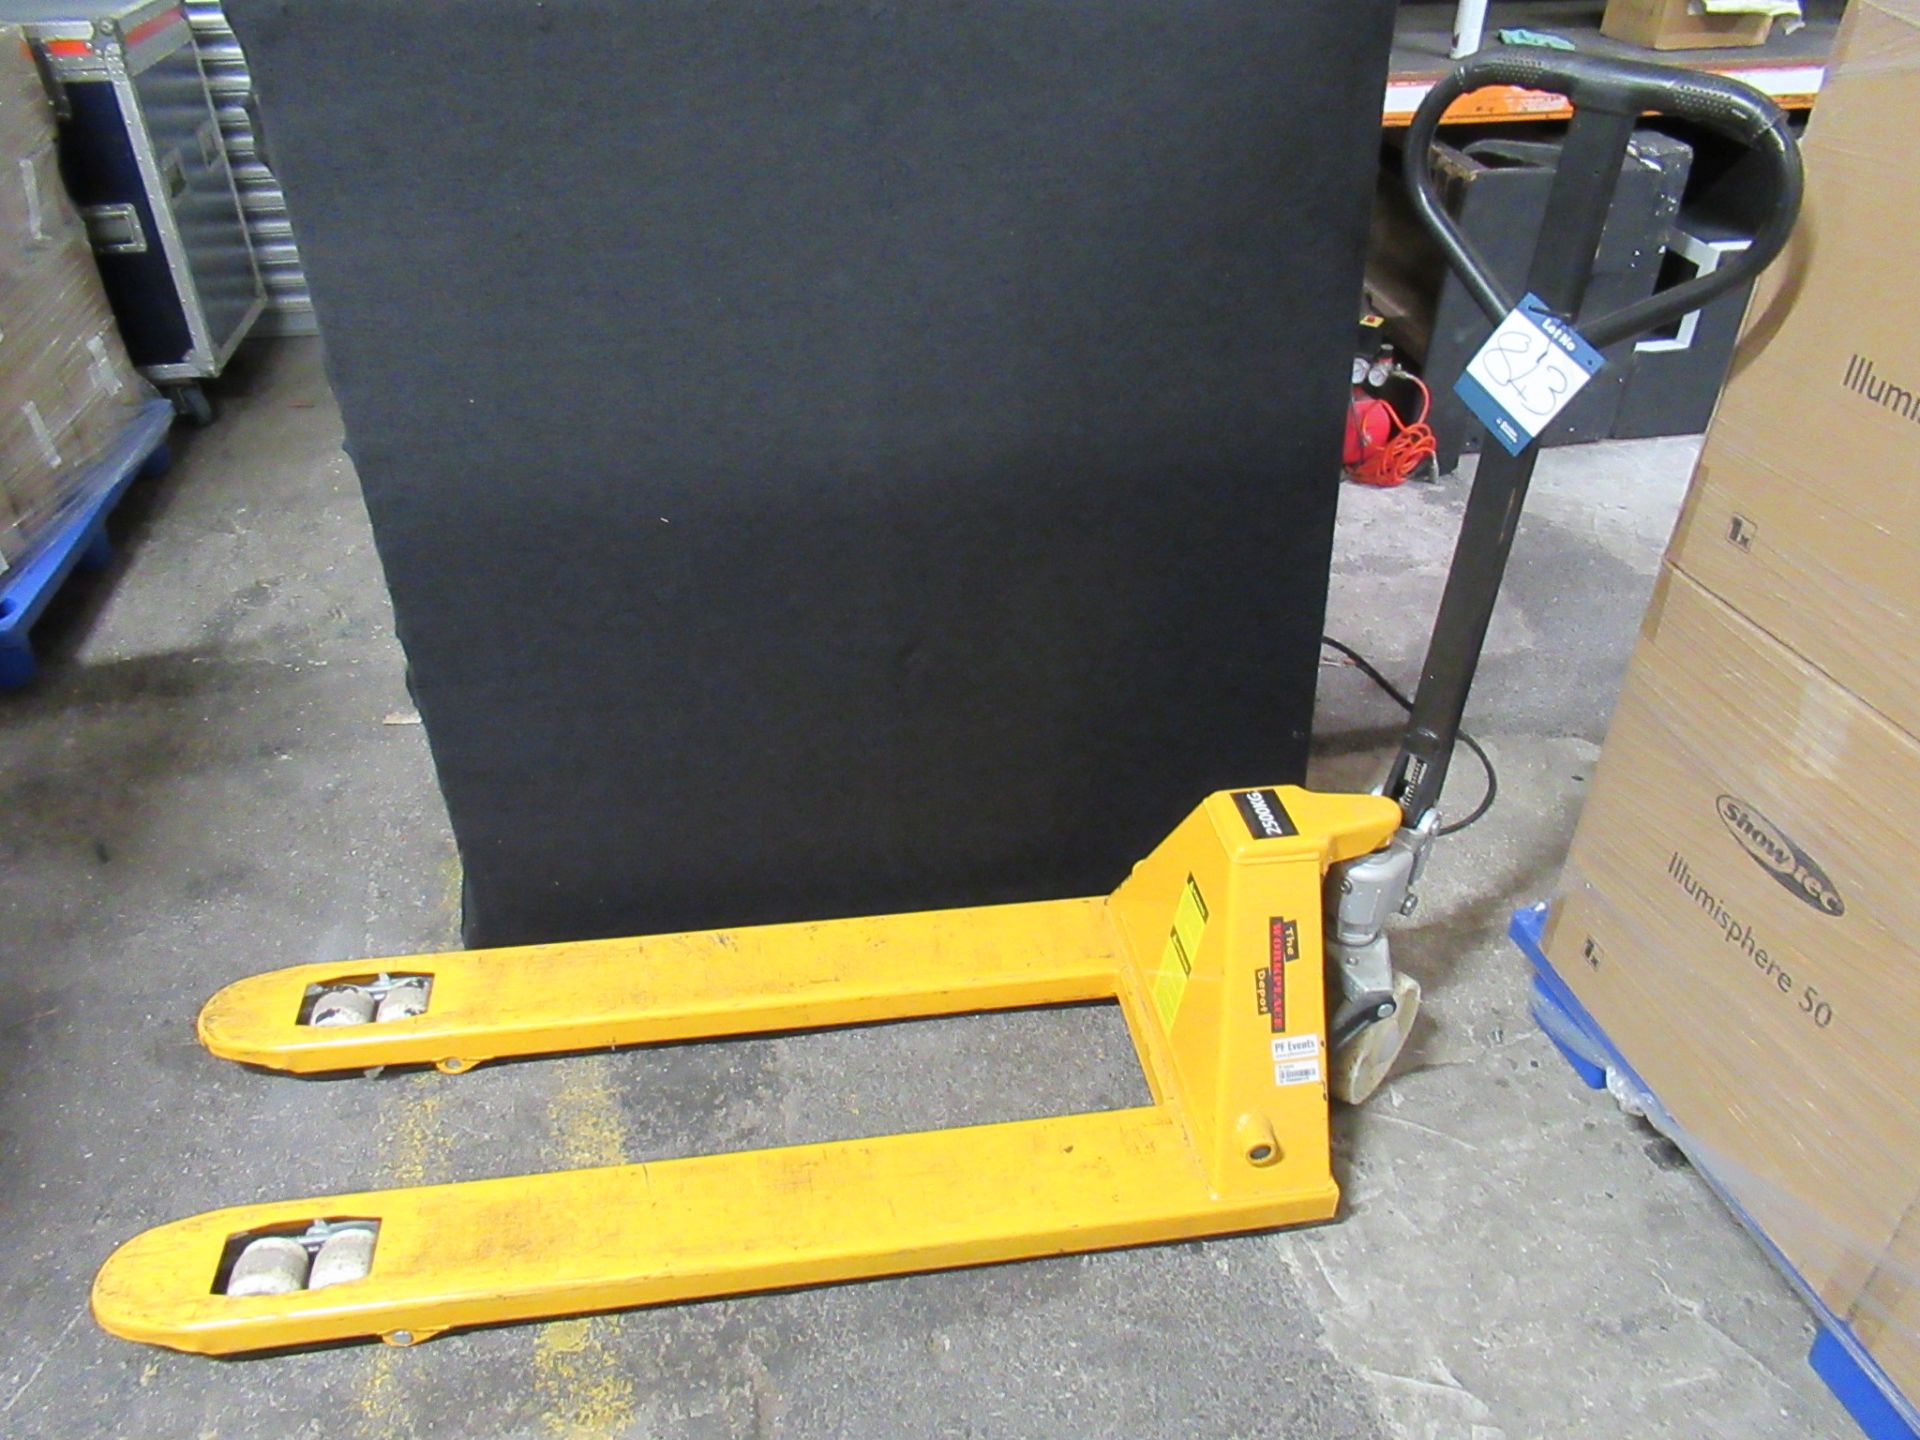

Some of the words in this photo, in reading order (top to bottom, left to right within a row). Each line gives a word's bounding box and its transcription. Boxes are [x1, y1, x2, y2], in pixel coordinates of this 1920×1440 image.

[1542, 318, 1562, 340] Lot
[1559, 334, 1577, 352] No
[1842, 353, 1920, 424] Illumi
[1246, 791, 1283, 836] 2500KG
[1285, 927, 1295, 956] The
[1668, 851, 1793, 994] Illumisphere
[1798, 985, 1834, 1029] 50
[1257, 970, 1269, 1013] Depot
[1272, 923, 1284, 1029] WORKPLACE
[1288, 1039, 1315, 1052] Events
